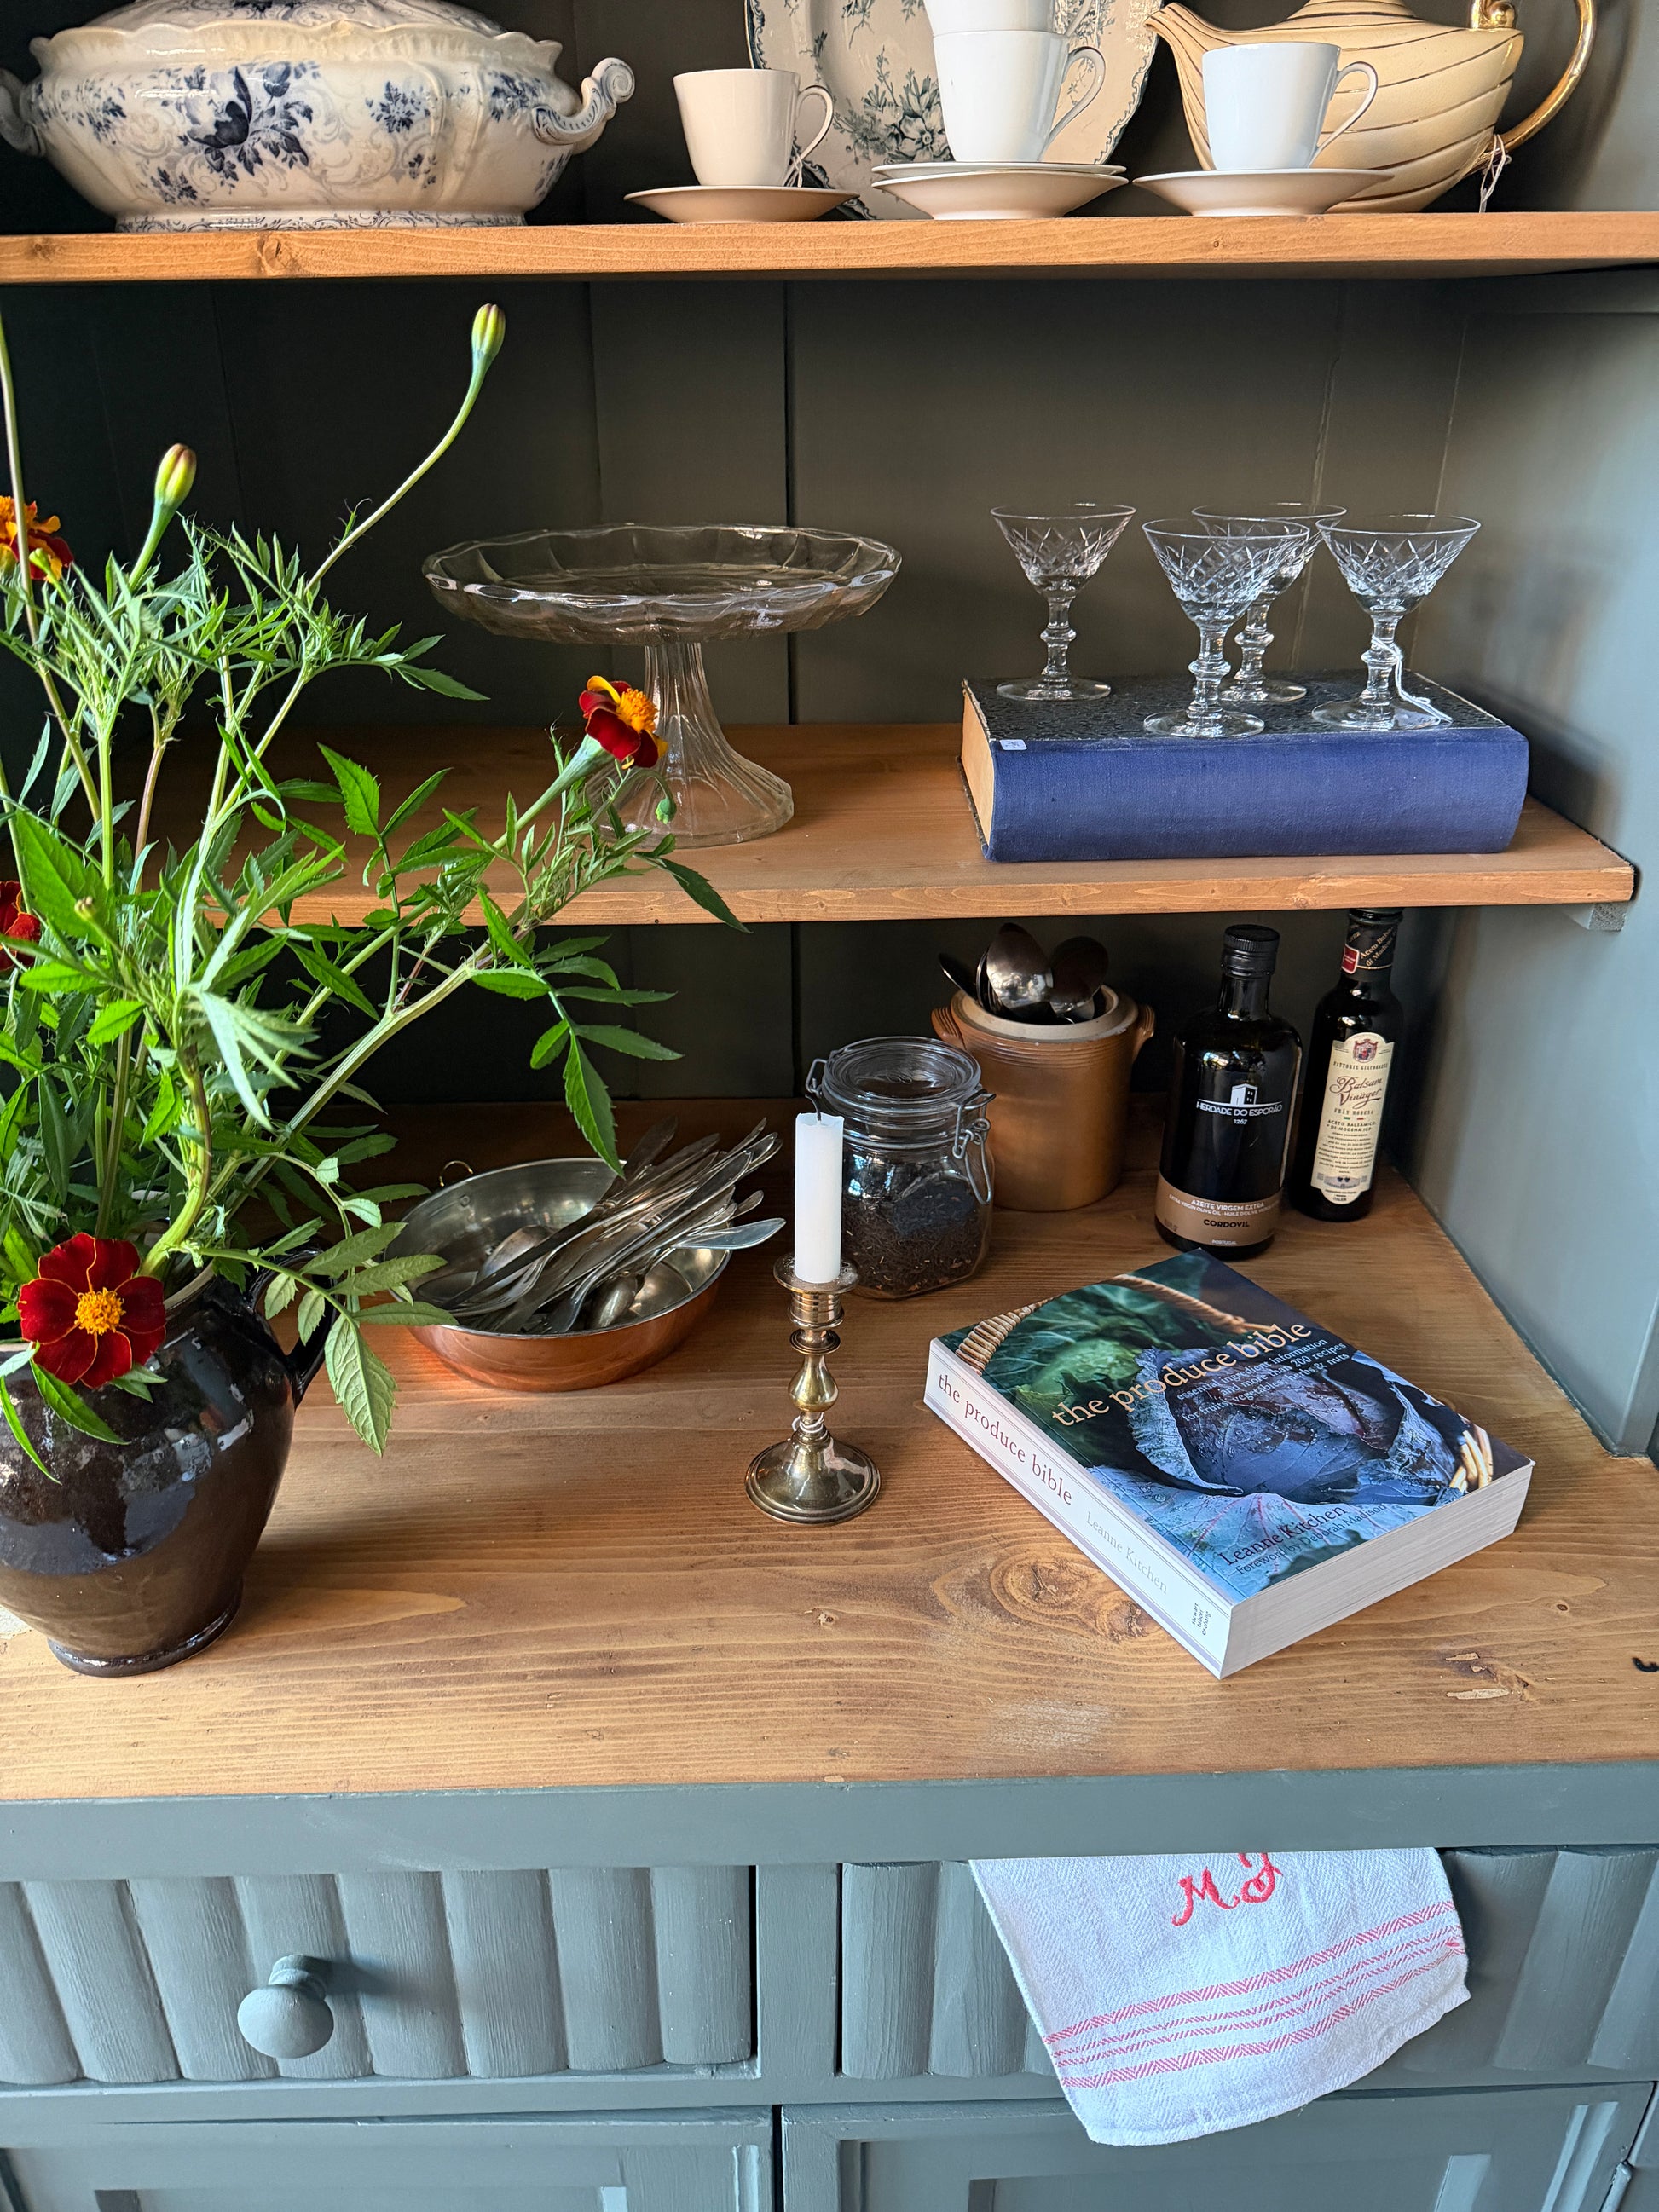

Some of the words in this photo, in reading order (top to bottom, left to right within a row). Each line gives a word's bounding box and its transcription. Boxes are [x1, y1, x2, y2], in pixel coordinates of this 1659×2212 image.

[1196, 1101, 1233, 1116] HERDADE
[1329, 1076, 1383, 1094] Balsam
[1191, 1199, 1215, 1210] AZEITE
[1217, 1204, 1245, 1212] VIRGEM
[1245, 1202, 1265, 1211] EXTRA
[1196, 1206, 1211, 1215] OLIVE
[1203, 1219, 1250, 1228] CORDOVIL
[1052, 1401, 1110, 1427] the
[1108, 1350, 1237, 1412] produce
[1227, 1323, 1312, 1360] bible
[1176, 1377, 1222, 1401] essential
[1220, 1361, 1273, 1385] ingredient
[1271, 1337, 1328, 1366] information
[1181, 1411, 1199, 1422] for
[1287, 1366, 1314, 1381] herbs
[1314, 1360, 1327, 1371] &
[1327, 1352, 1350, 1366] nuts
[1218, 1382, 1241, 1396] and
[1240, 1374, 1269, 1388] more
[1269, 1364, 1292, 1378] than
[1290, 1354, 1311, 1368] 200
[1311, 1342, 1348, 1361] recipes
[939, 1373, 961, 1404] the
[964, 1400, 1026, 1464] produce
[1032, 1453, 1072, 1506] bible
[1085, 1511, 1124, 1553] Leanne
[1125, 1546, 1169, 1596] Kitchen
[1217, 1533, 1284, 1566] Leanne
[1277, 1505, 1349, 1539] Kitchen
[1234, 1548, 1287, 1575] Foreword
[1287, 1543, 1301, 1558] by
[1300, 1522, 1345, 1546] Deborah
[1343, 1503, 1387, 1527] Madison
